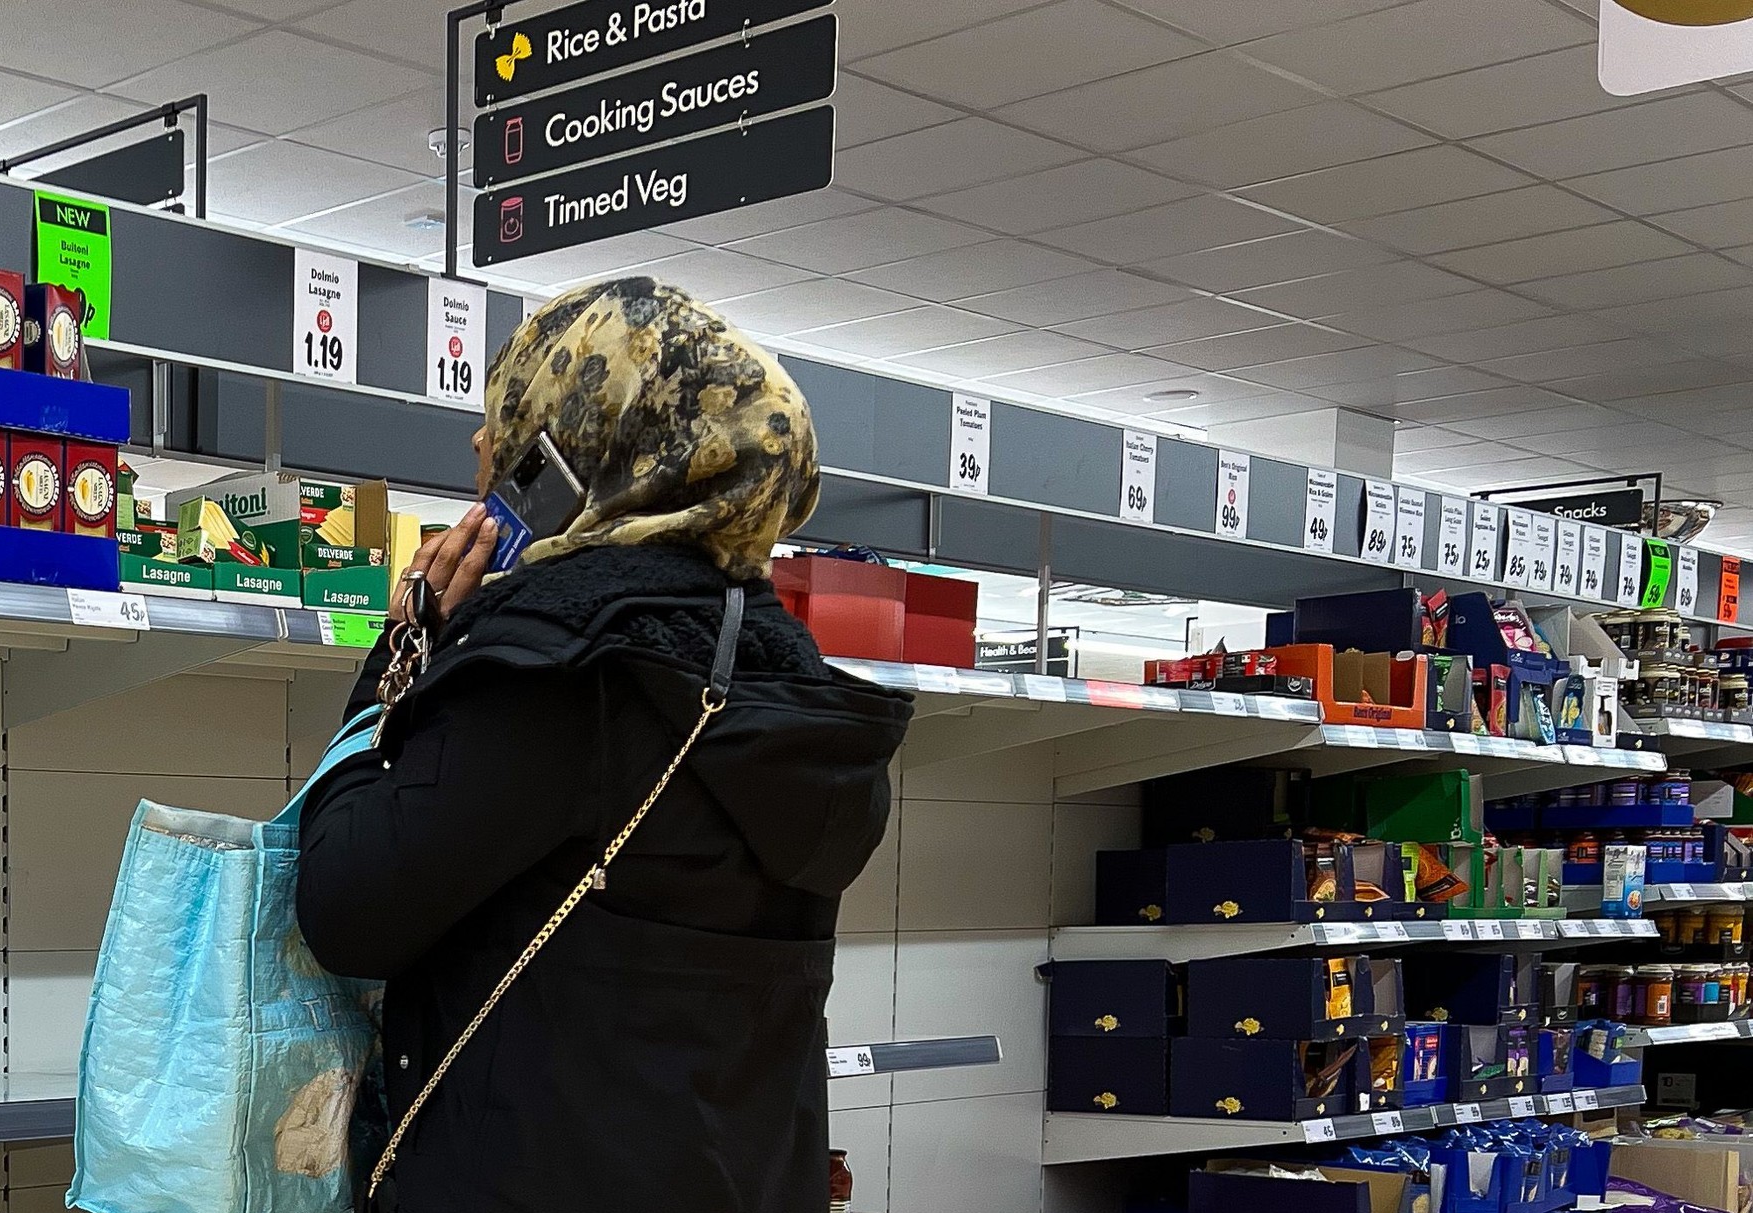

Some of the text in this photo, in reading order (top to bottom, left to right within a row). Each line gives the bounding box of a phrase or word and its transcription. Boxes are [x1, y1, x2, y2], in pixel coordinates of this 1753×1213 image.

[546, 0, 707, 64] Rice & Pasta
[545, 70, 760, 147] Cooking Sauces
[544, 170, 688, 228] Tinned Veg
[56, 204, 91, 228] NEW
[59, 253, 91, 270] Lasagne
[311, 268, 340, 285] Dolmio
[308, 282, 342, 300] Lasagne
[443, 296, 469, 312] Dolmio
[444, 311, 467, 326] Sauce
[304, 331, 343, 371] 1.19
[437, 356, 472, 394] 1.19
[959, 418, 983, 430] Tomatoes
[959, 452, 981, 482] 39p
[1128, 485, 1147, 513] 69p
[1554, 501, 1607, 519] Snacks
[1222, 504, 1240, 531] 99p
[1310, 516, 1328, 542] 49p
[1368, 528, 1387, 553] 89p
[1401, 534, 1417, 560] 75p
[317, 547, 354, 561] DELVERDE
[1444, 543, 1459, 567] 75p
[1475, 549, 1490, 571] 25p
[142, 564, 191, 584] Lasagne
[1534, 559, 1547, 582] 79p
[236, 573, 283, 591] Lasagne
[323, 589, 370, 606] Lasagne
[120, 601, 145, 622] 45p
[980, 644, 1009, 658] Health
[1009, 645, 1017, 655] &
[857, 1052, 871, 1067] 99p
